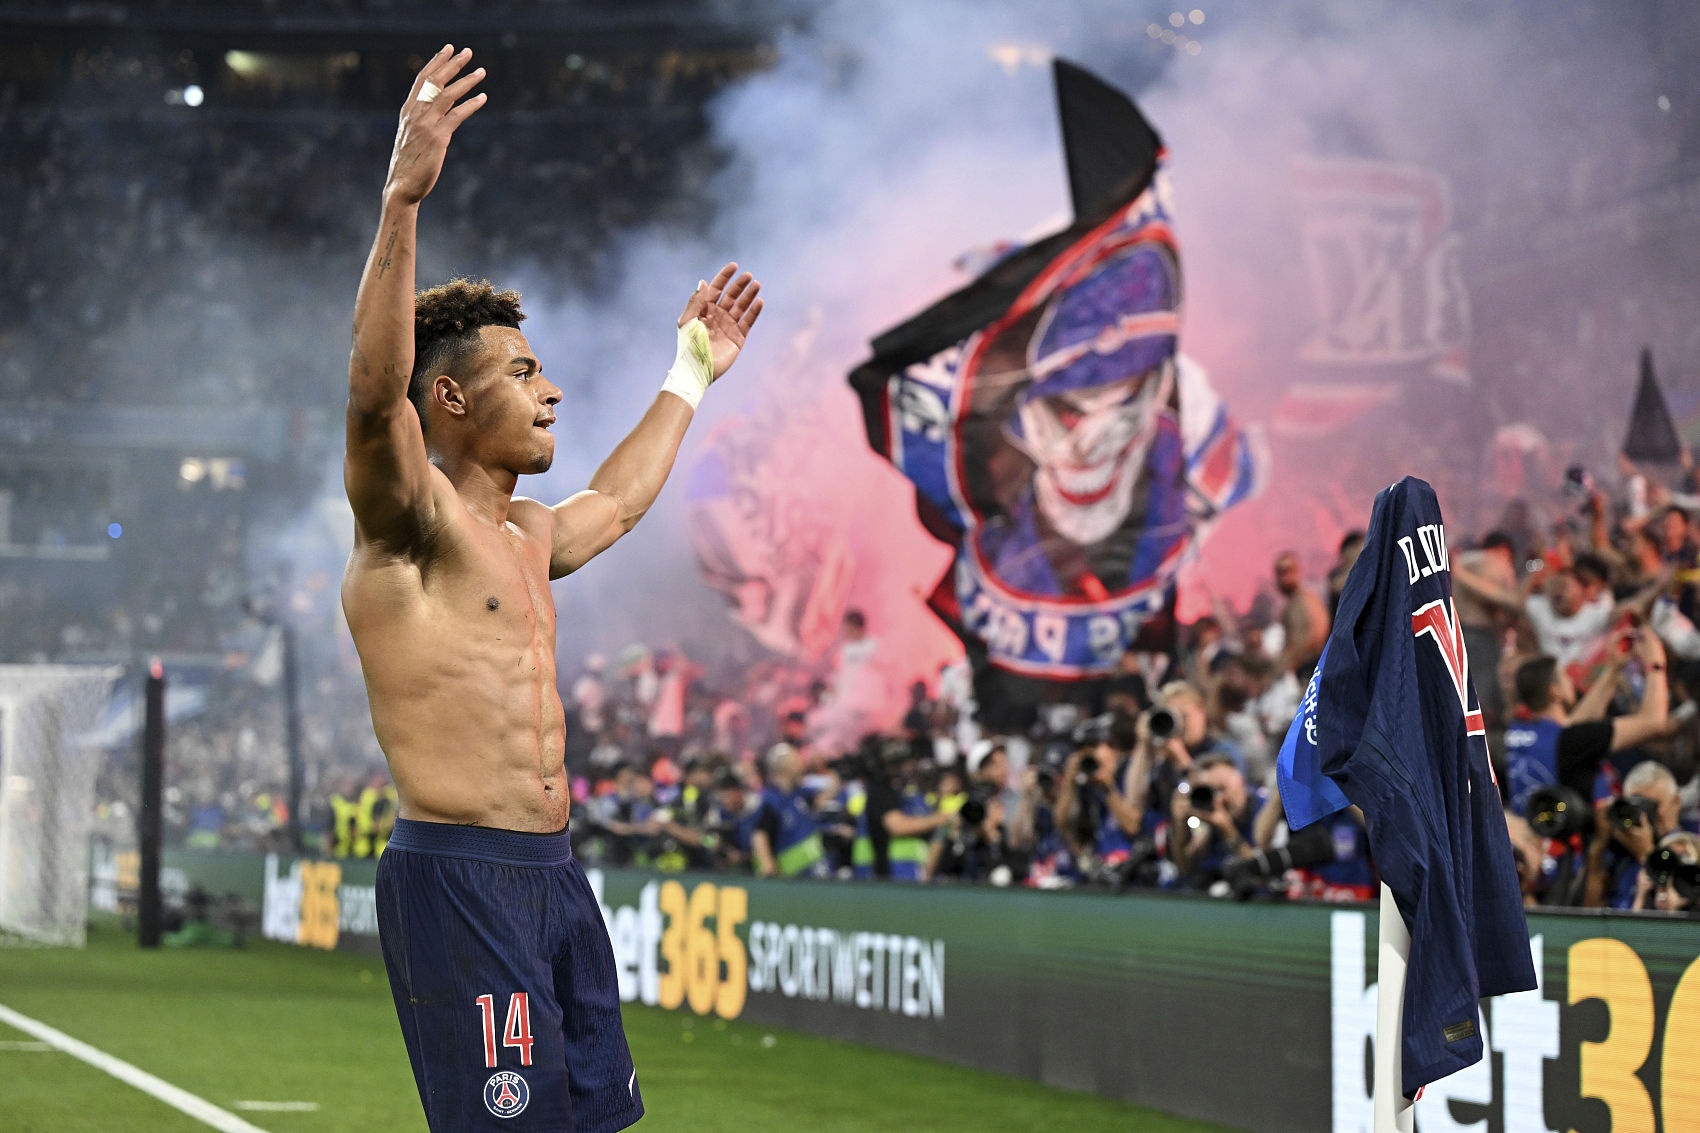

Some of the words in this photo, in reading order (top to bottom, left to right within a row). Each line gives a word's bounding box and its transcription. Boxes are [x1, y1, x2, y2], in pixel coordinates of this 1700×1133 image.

[587, 868, 748, 1019] et365
[749, 920, 946, 1030] SPORTWETTEN
[475, 992, 534, 1067] 14
[489, 1073, 520, 1087] PARIS
